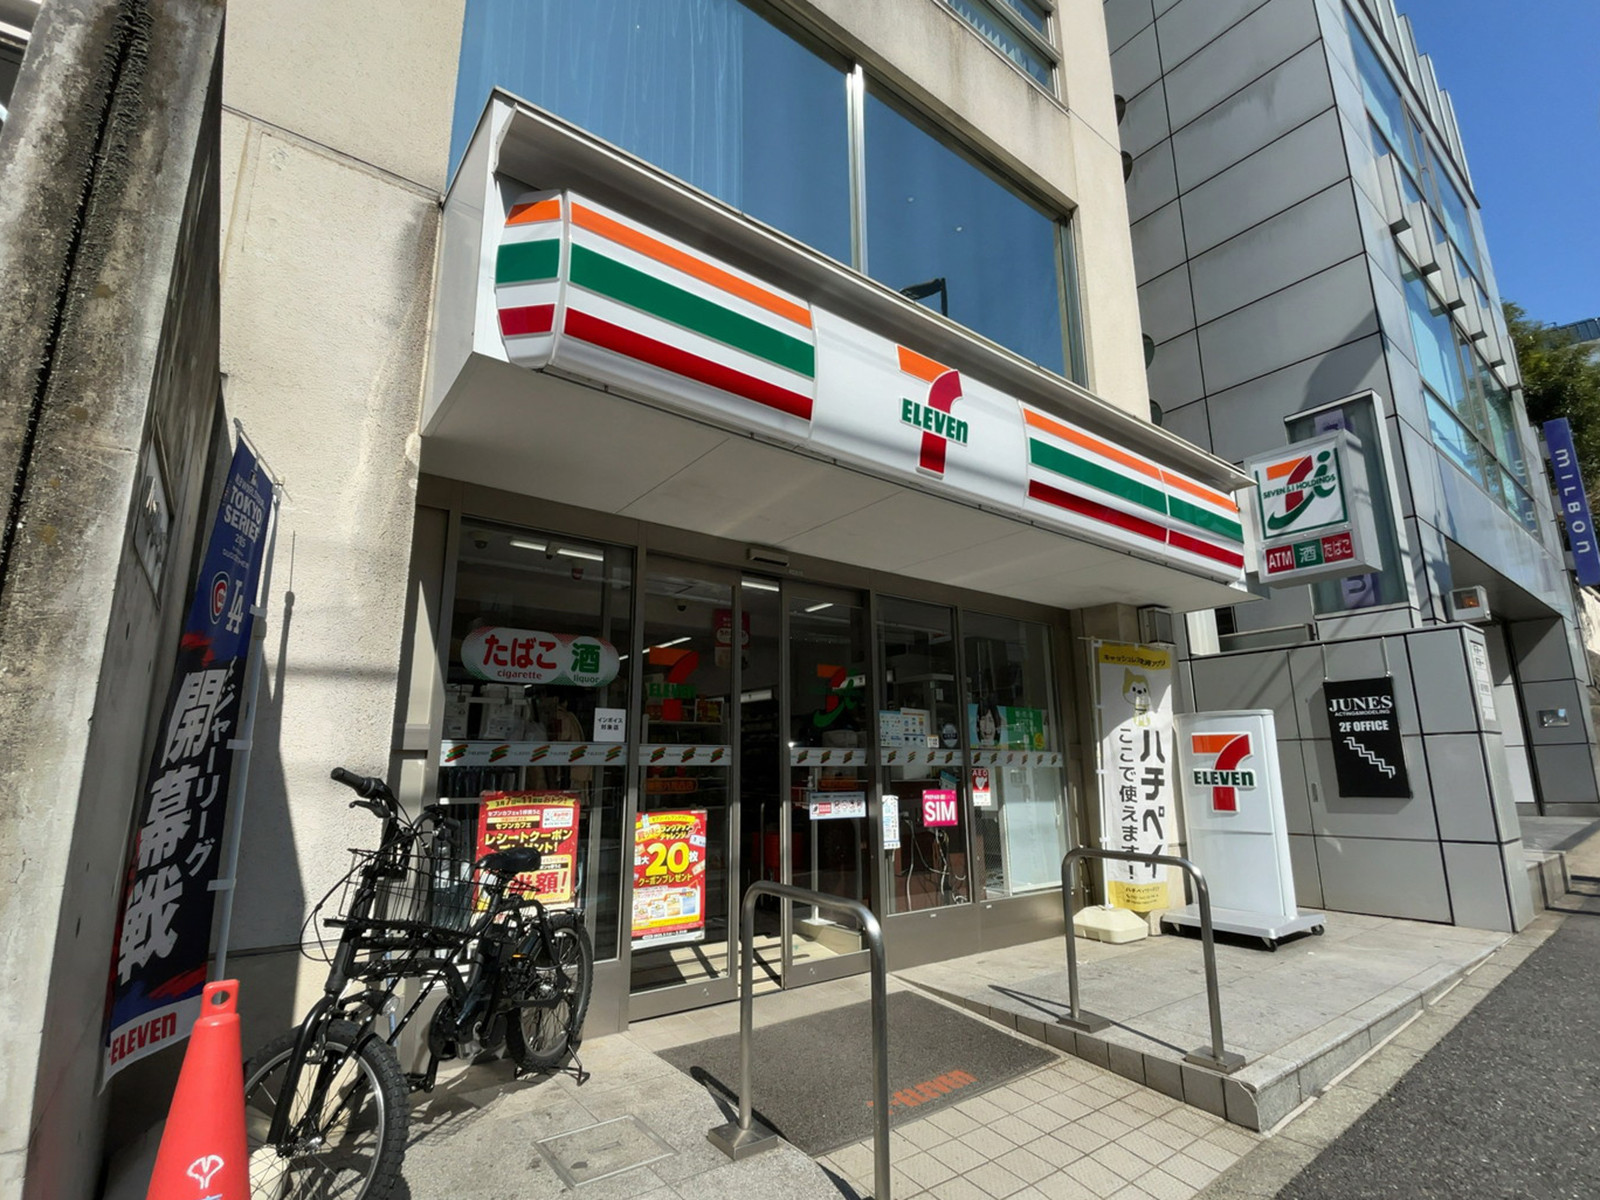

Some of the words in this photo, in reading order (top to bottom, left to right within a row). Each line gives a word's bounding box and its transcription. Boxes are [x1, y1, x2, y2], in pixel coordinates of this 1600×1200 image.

[1263, 487, 1286, 500] SEVEN
[1296, 473, 1337, 492] HOLDINGS
[229, 484, 263, 525] TOKYO
[1298, 544, 1317, 564] 酒
[1323, 538, 1352, 558] たばこ
[1268, 550, 1294, 569] ATM
[483, 633, 558, 670] たばこ
[570, 641, 601, 674] 酒
[496, 668, 543, 681] cigarette
[573, 673, 601, 685] liquor
[1328, 694, 1394, 712] JUNES
[1338, 721, 1352, 733] 2F
[1353, 720, 1390, 732] OFFICE
[924, 800, 956, 822] SIM
[117, 669, 228, 986] 開幕戦
[484, 829, 573, 846] レシートクーポン
[645, 841, 691, 877] 20
[689, 850, 699, 863] 枚
